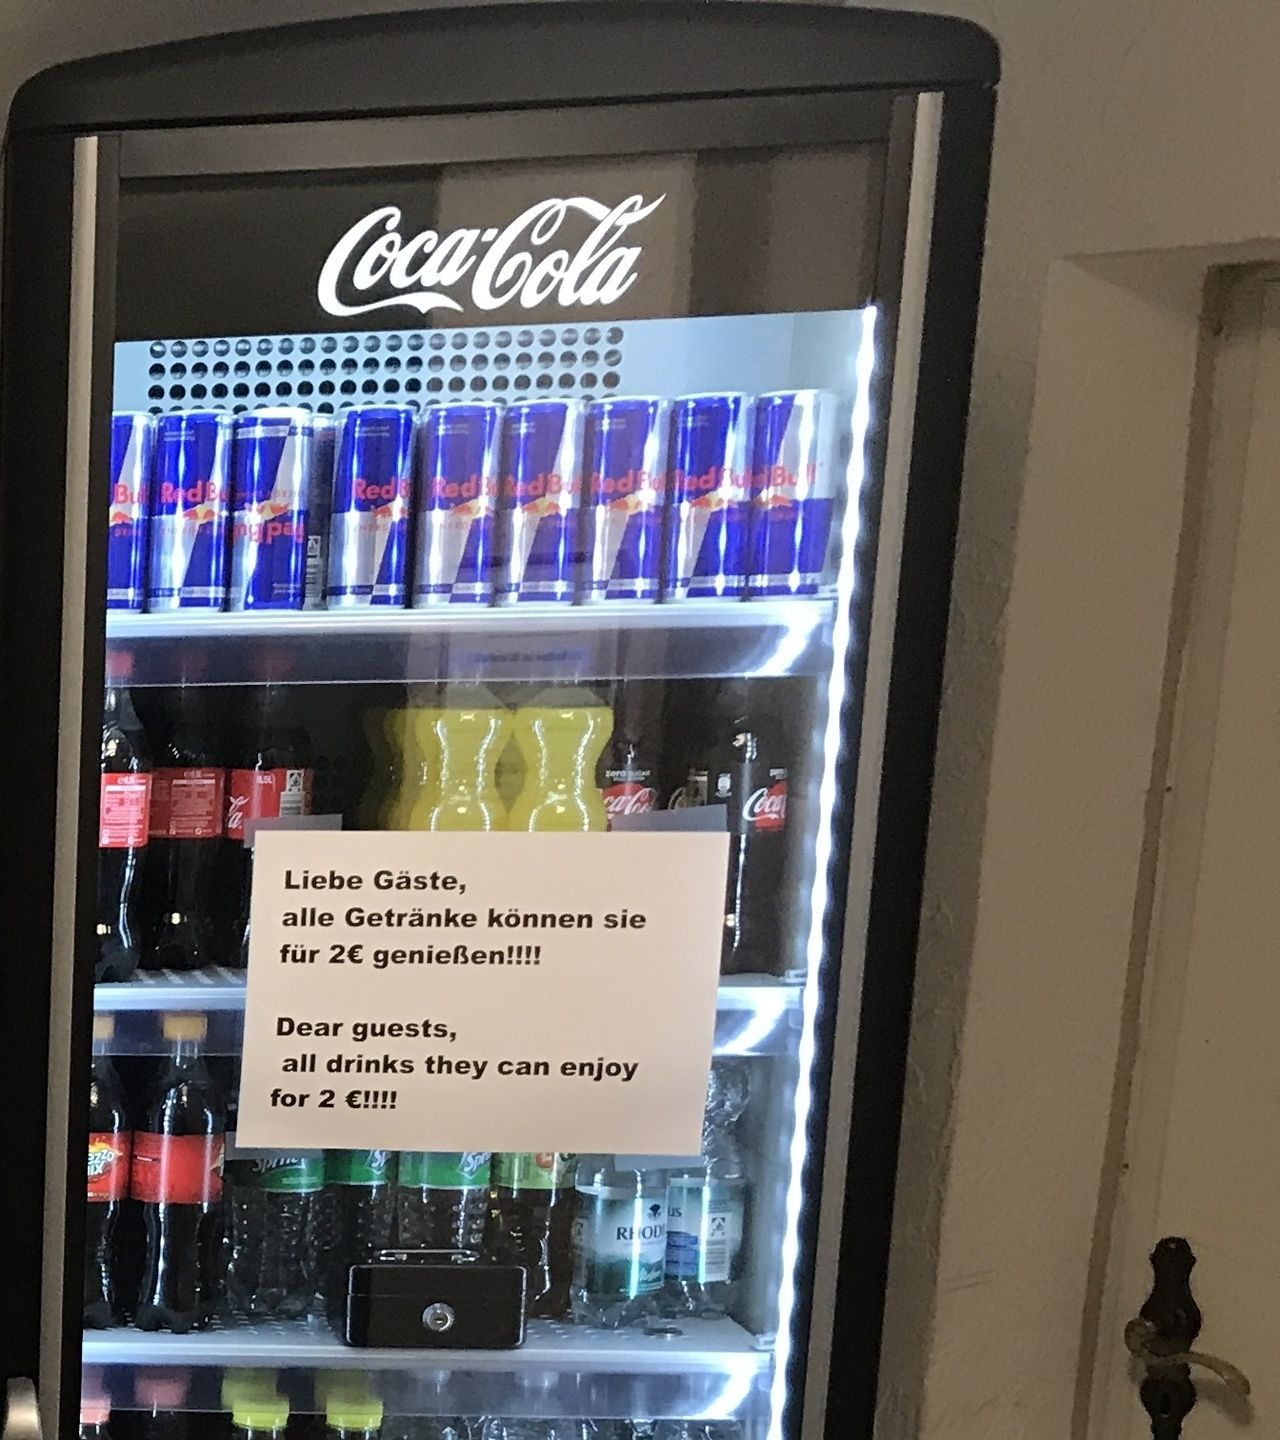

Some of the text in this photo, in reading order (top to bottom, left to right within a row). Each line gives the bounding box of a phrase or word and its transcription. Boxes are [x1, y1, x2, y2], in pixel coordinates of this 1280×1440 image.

[317, 192, 667, 318] Coca-Cola
[284, 867, 466, 895] Liebe Gäste,
[282, 907, 646, 929] alle Getränke können sie
[279, 943, 541, 970] für 2€ genießen!!!!
[276, 1017, 457, 1043] Dear guests,
[281, 1053, 639, 1082] all drinks they can enjoy
[270, 1088, 397, 1110] for 2 €!!!!
